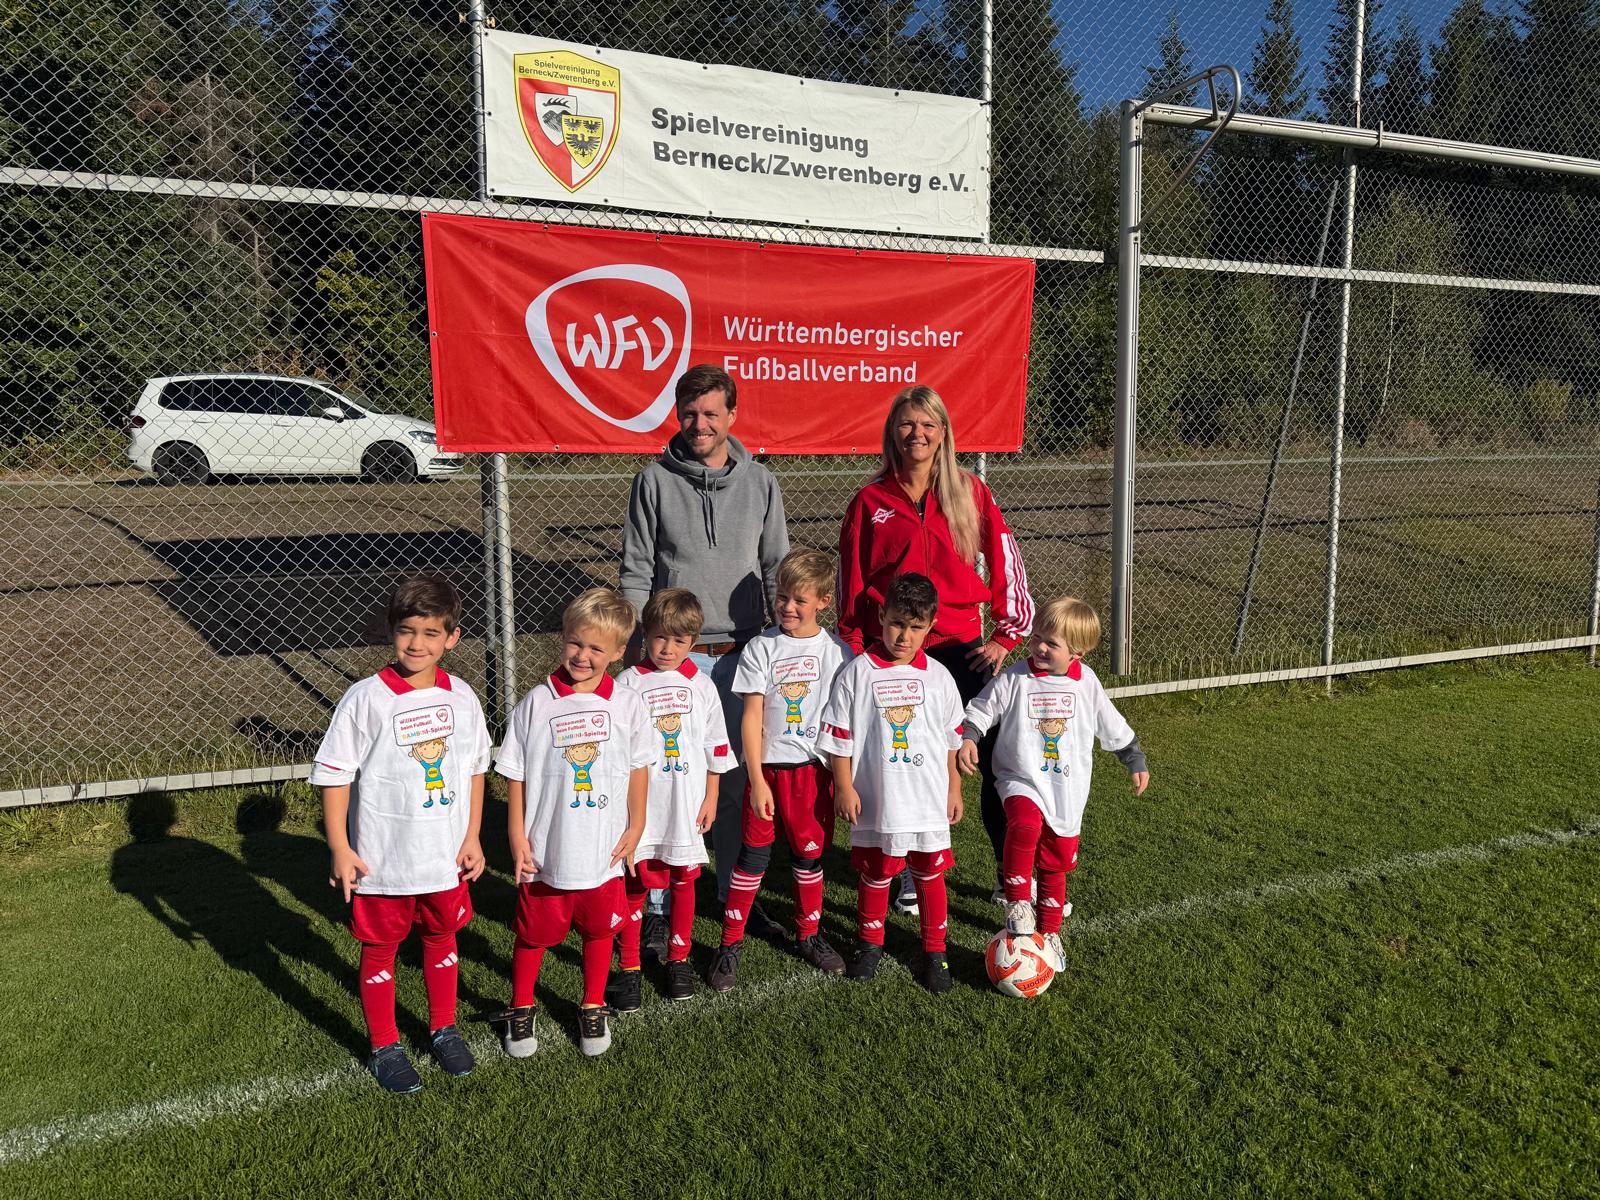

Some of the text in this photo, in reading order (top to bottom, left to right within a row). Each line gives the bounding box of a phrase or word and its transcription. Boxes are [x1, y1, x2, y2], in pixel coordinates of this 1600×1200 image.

[518, 65, 617, 88] Berneck/Zwerenberg e.V.
[534, 59, 601, 77] Spielvereinigung
[651, 107, 869, 158] Spielvereinigung
[653, 142, 970, 194] Berneck/Zwerenberg e.V.
[723, 315, 964, 349] Württembergischer
[723, 356, 918, 383] Fußballverband
